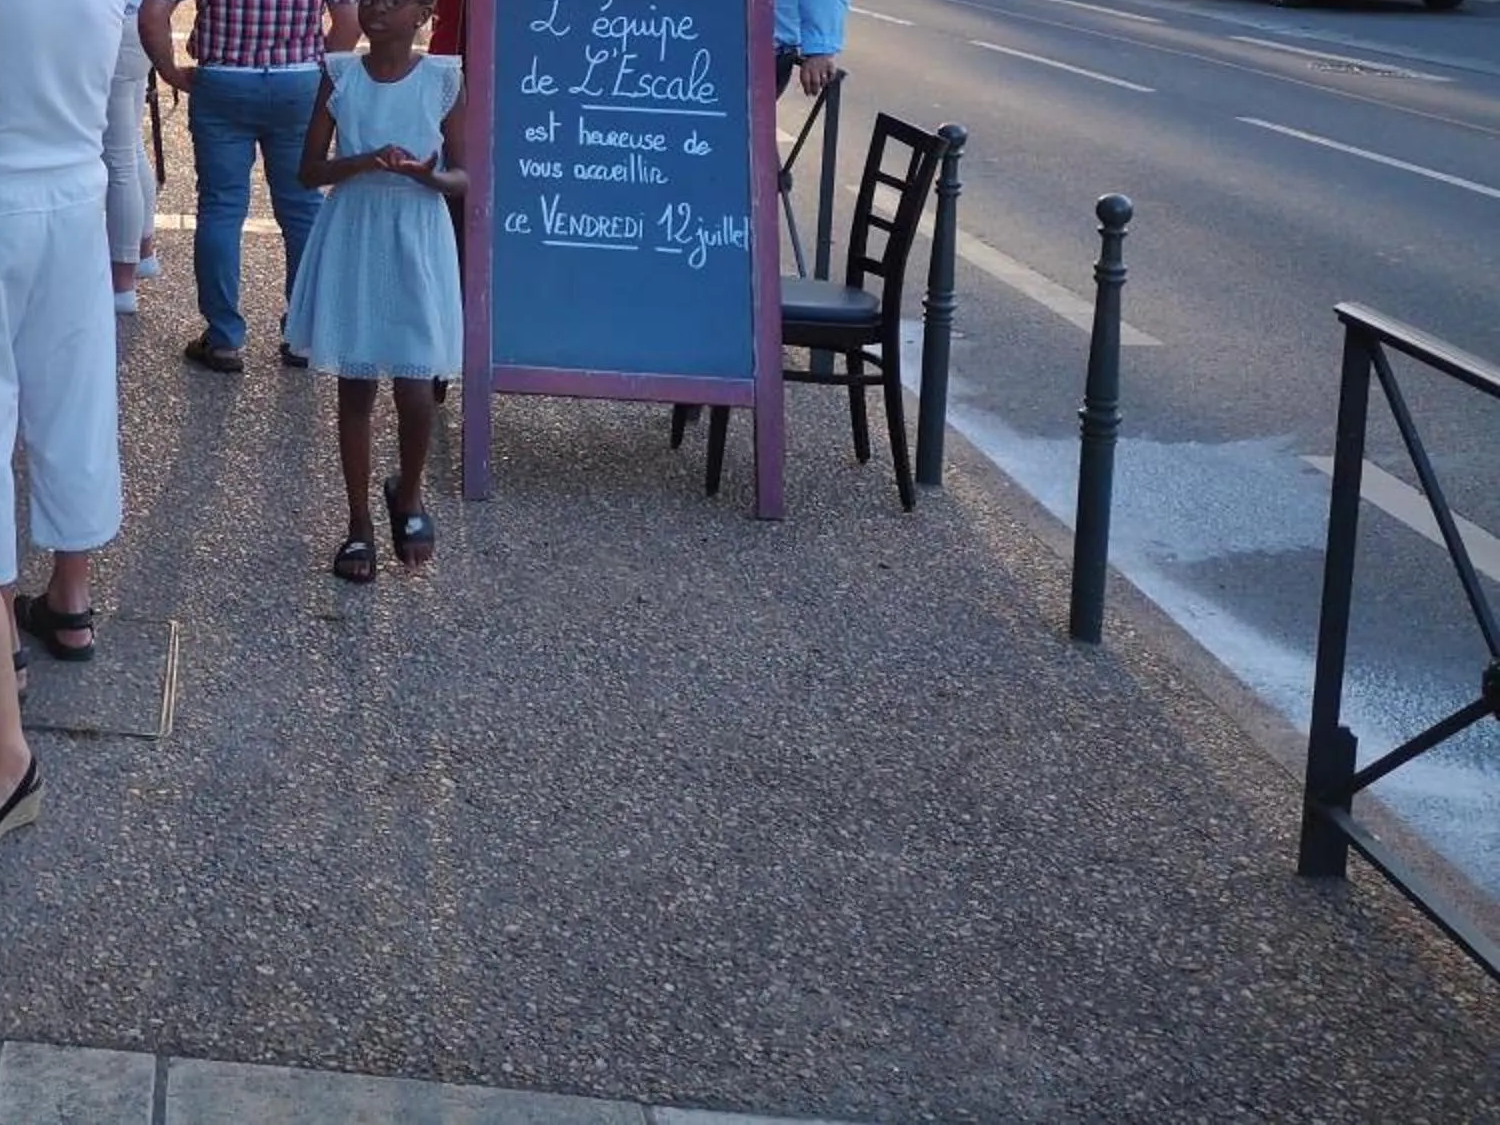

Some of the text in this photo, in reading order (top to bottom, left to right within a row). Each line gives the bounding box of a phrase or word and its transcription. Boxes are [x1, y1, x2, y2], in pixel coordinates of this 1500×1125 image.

[521, 45, 719, 104] de L'Escale
[525, 110, 713, 156] est heureuse de
[573, 153, 669, 184] accueillir
[504, 211, 532, 234] ce
[657, 202, 693, 245] 12
